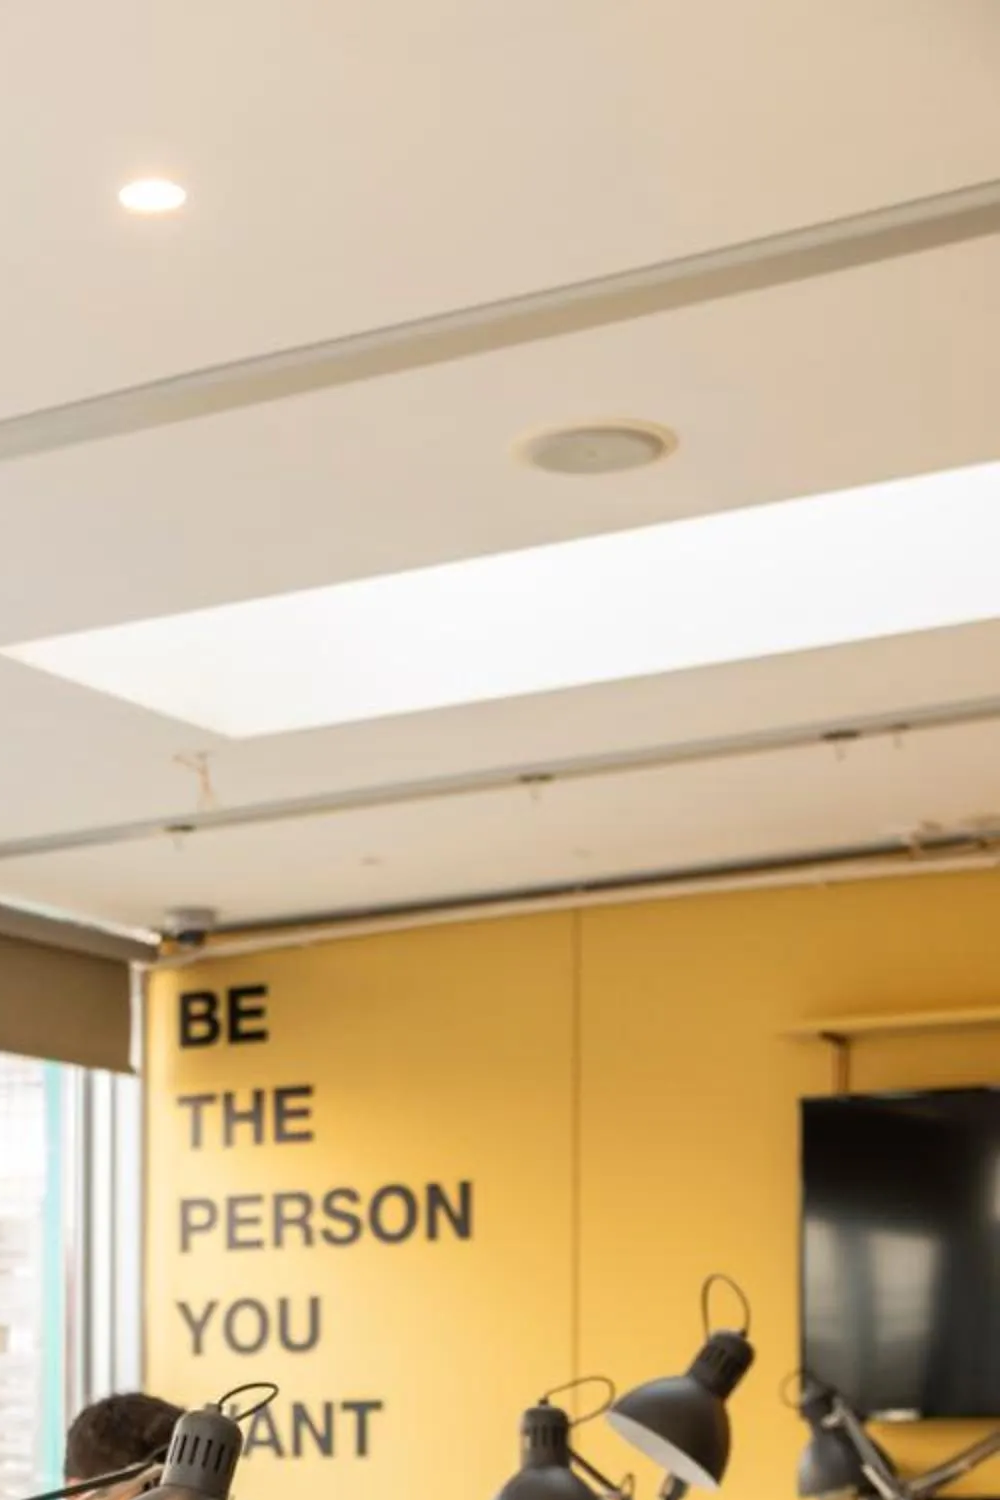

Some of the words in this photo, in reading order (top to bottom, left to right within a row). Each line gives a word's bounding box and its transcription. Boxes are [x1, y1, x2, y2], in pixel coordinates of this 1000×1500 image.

[178, 985, 269, 1048] BE
[177, 1084, 315, 1149] THE
[179, 1180, 472, 1253] PERSON
[176, 1295, 321, 1356] YOU
[229, 1400, 383, 1459] ANT
